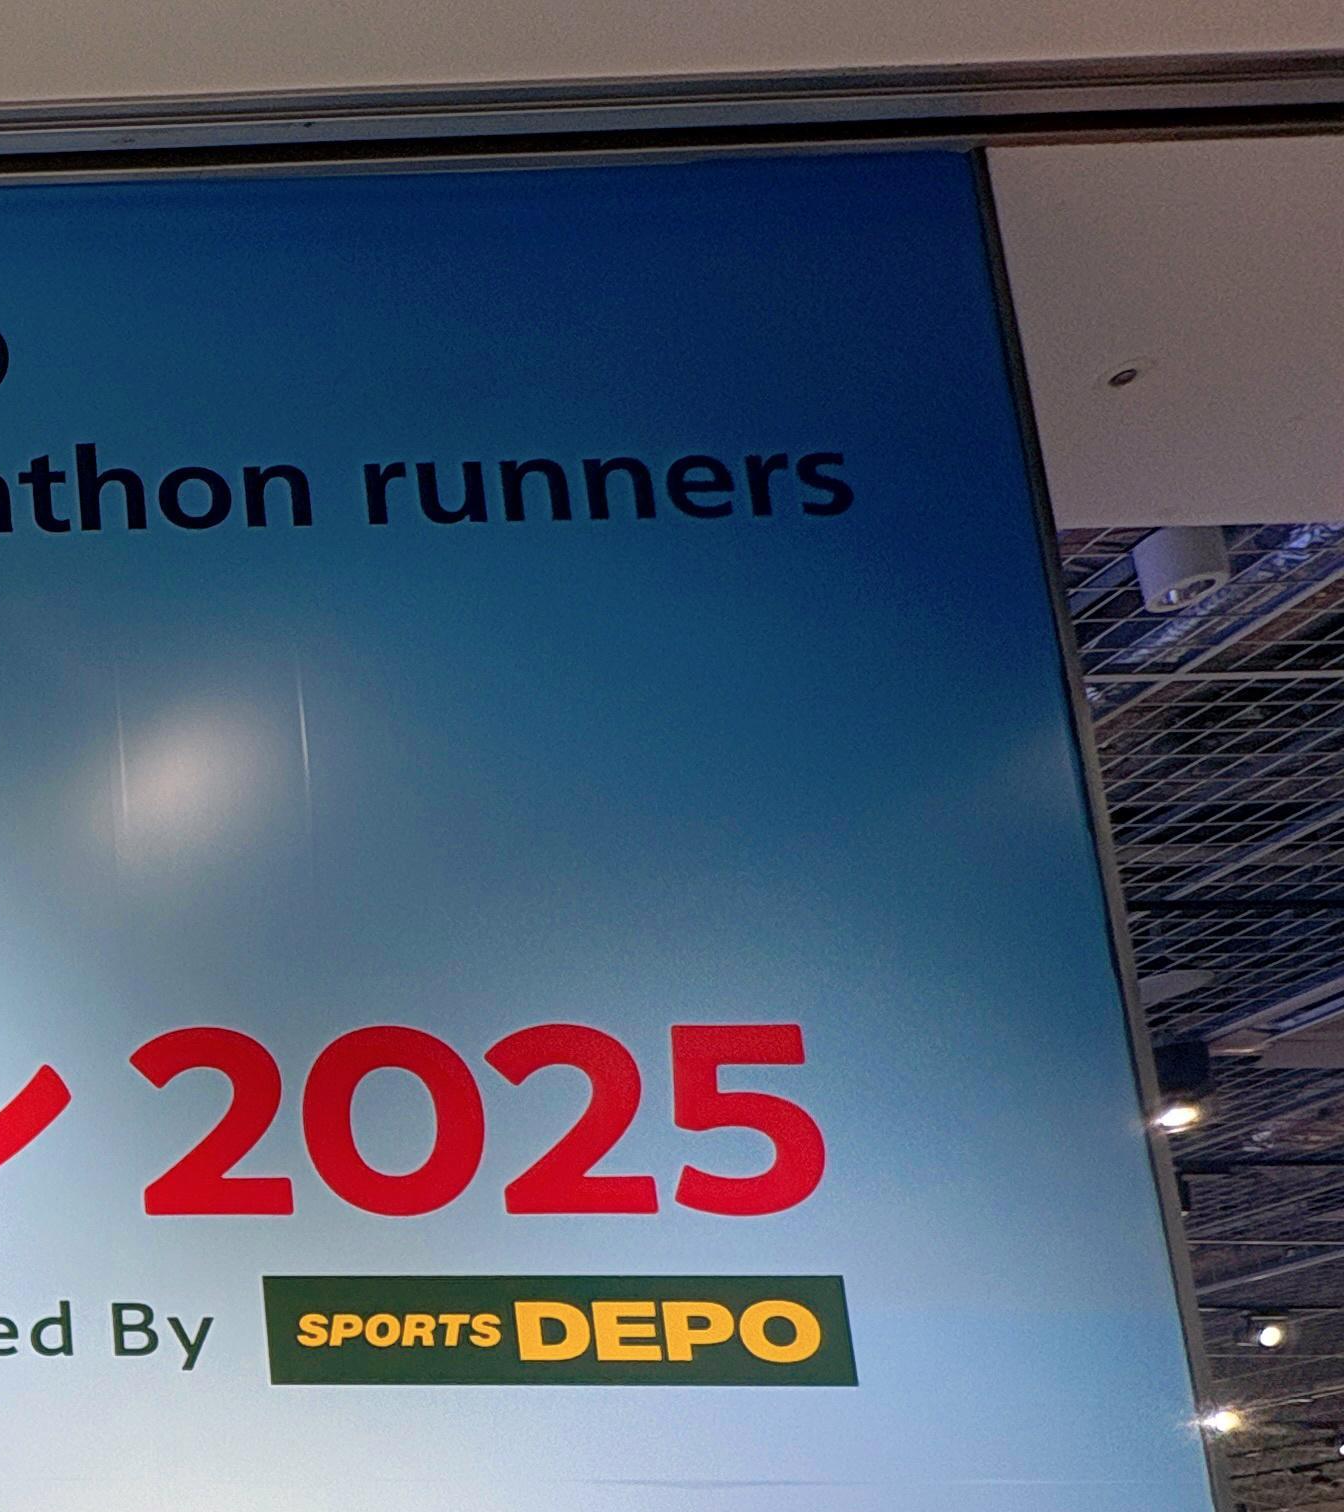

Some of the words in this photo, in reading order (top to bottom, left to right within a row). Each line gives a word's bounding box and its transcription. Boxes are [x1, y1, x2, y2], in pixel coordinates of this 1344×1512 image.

[362, 448, 857, 527] runners
[128, 1022, 828, 1217] 2025
[110, 1300, 215, 1371] By
[295, 1312, 502, 1349] SPORTS
[515, 1299, 823, 1363] DEPO
